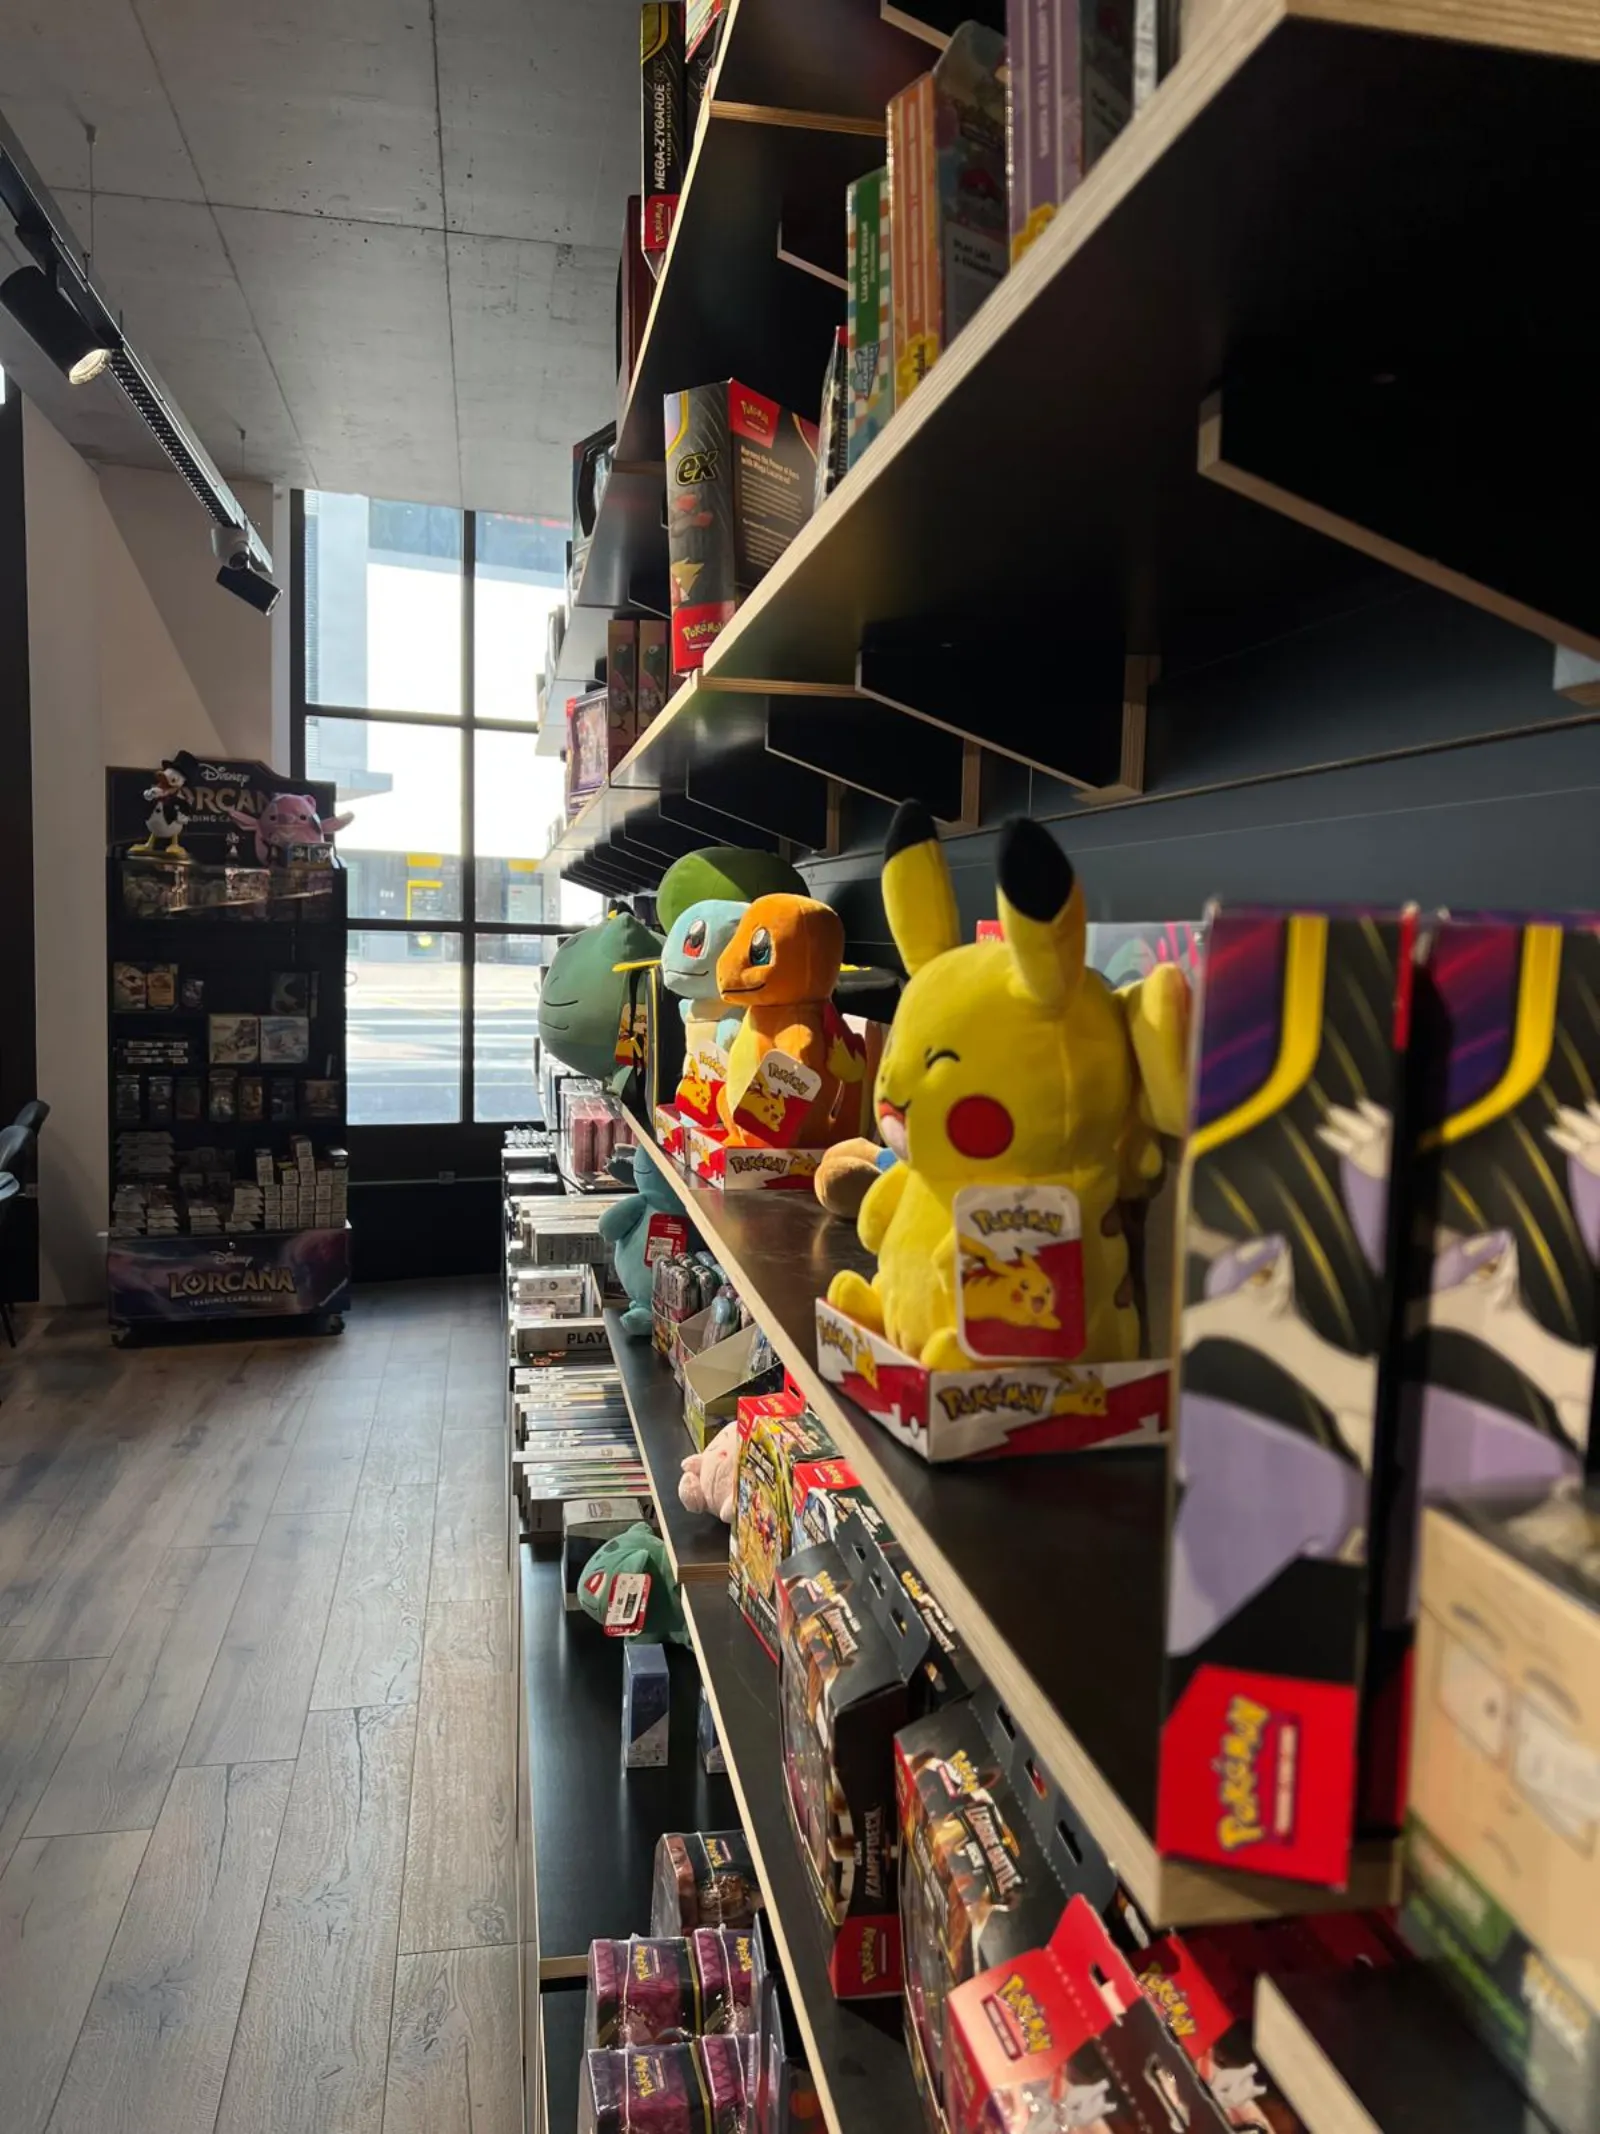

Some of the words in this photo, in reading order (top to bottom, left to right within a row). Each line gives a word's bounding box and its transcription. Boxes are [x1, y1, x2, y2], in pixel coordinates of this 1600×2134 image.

[653, 82, 666, 190] MEGA-ZYGARDE
[676, 451, 719, 486] ex
[201, 763, 249, 788] Disney
[767, 1061, 810, 1096] Pokémon
[729, 1151, 788, 1175] Pokémon
[969, 1204, 1063, 1237] Pokémon
[168, 1269, 296, 1300] LORCANA
[936, 1376, 1051, 1421] Pokémon
[1217, 1693, 1270, 1852] Pokémon
[996, 1972, 1051, 2055] Pokémon
